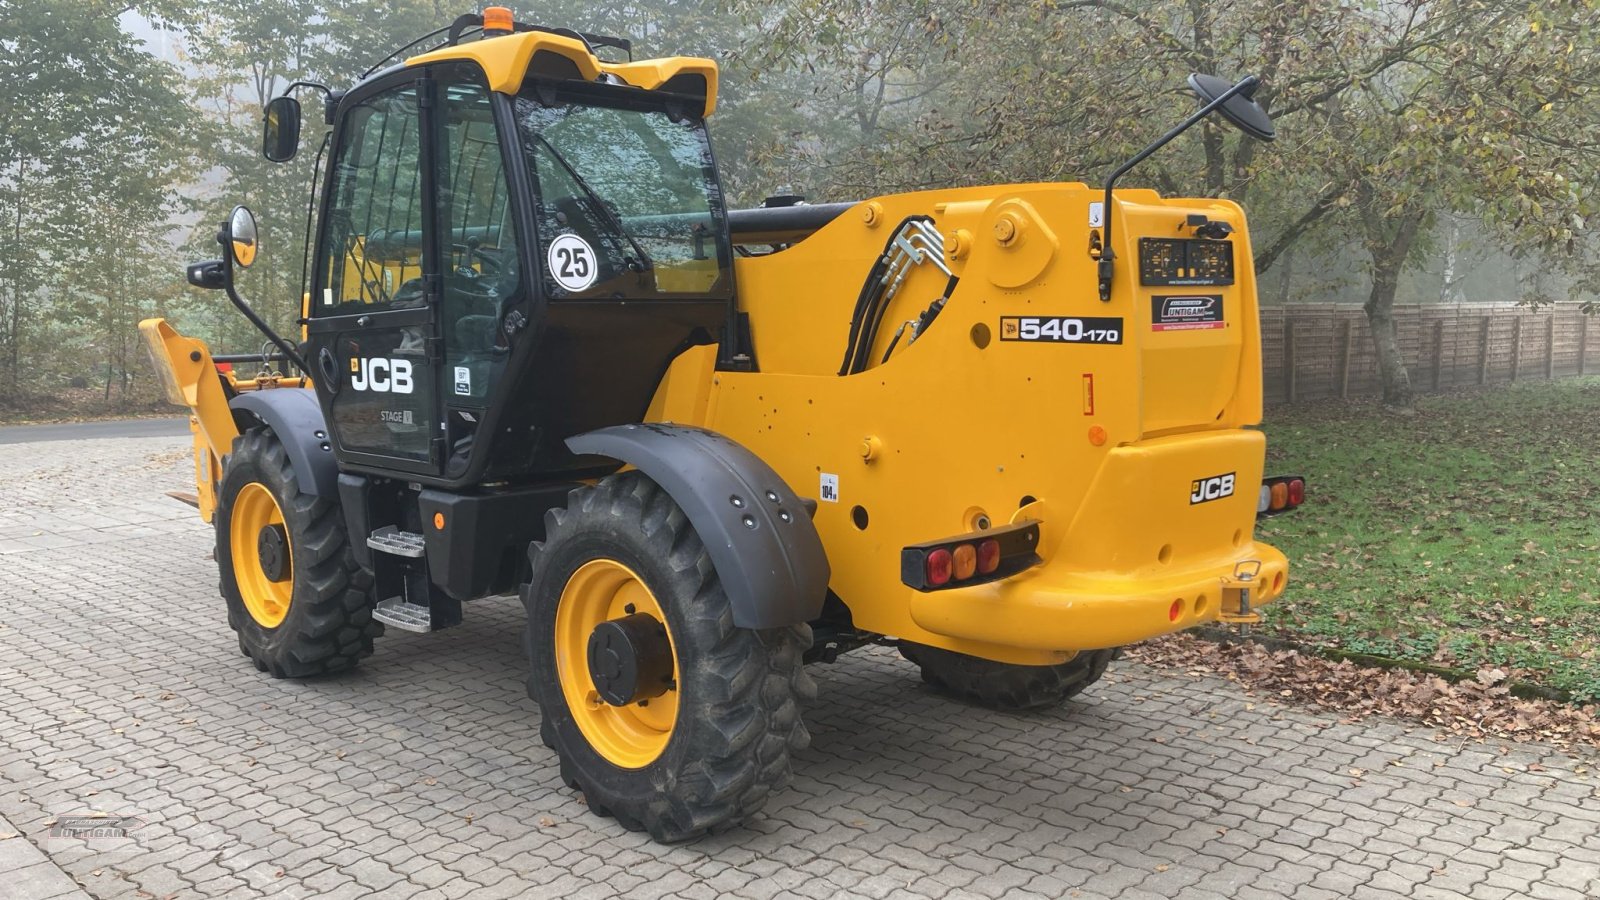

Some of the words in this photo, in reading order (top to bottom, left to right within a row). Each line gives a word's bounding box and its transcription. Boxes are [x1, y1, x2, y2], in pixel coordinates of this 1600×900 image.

[557, 248, 589, 277] 25
[1020, 318, 1119, 342] 540-170
[351, 358, 413, 394] JCB
[380, 410, 402, 422] STAGE
[822, 485, 833, 499] 104
[1191, 474, 1235, 503] JCB
